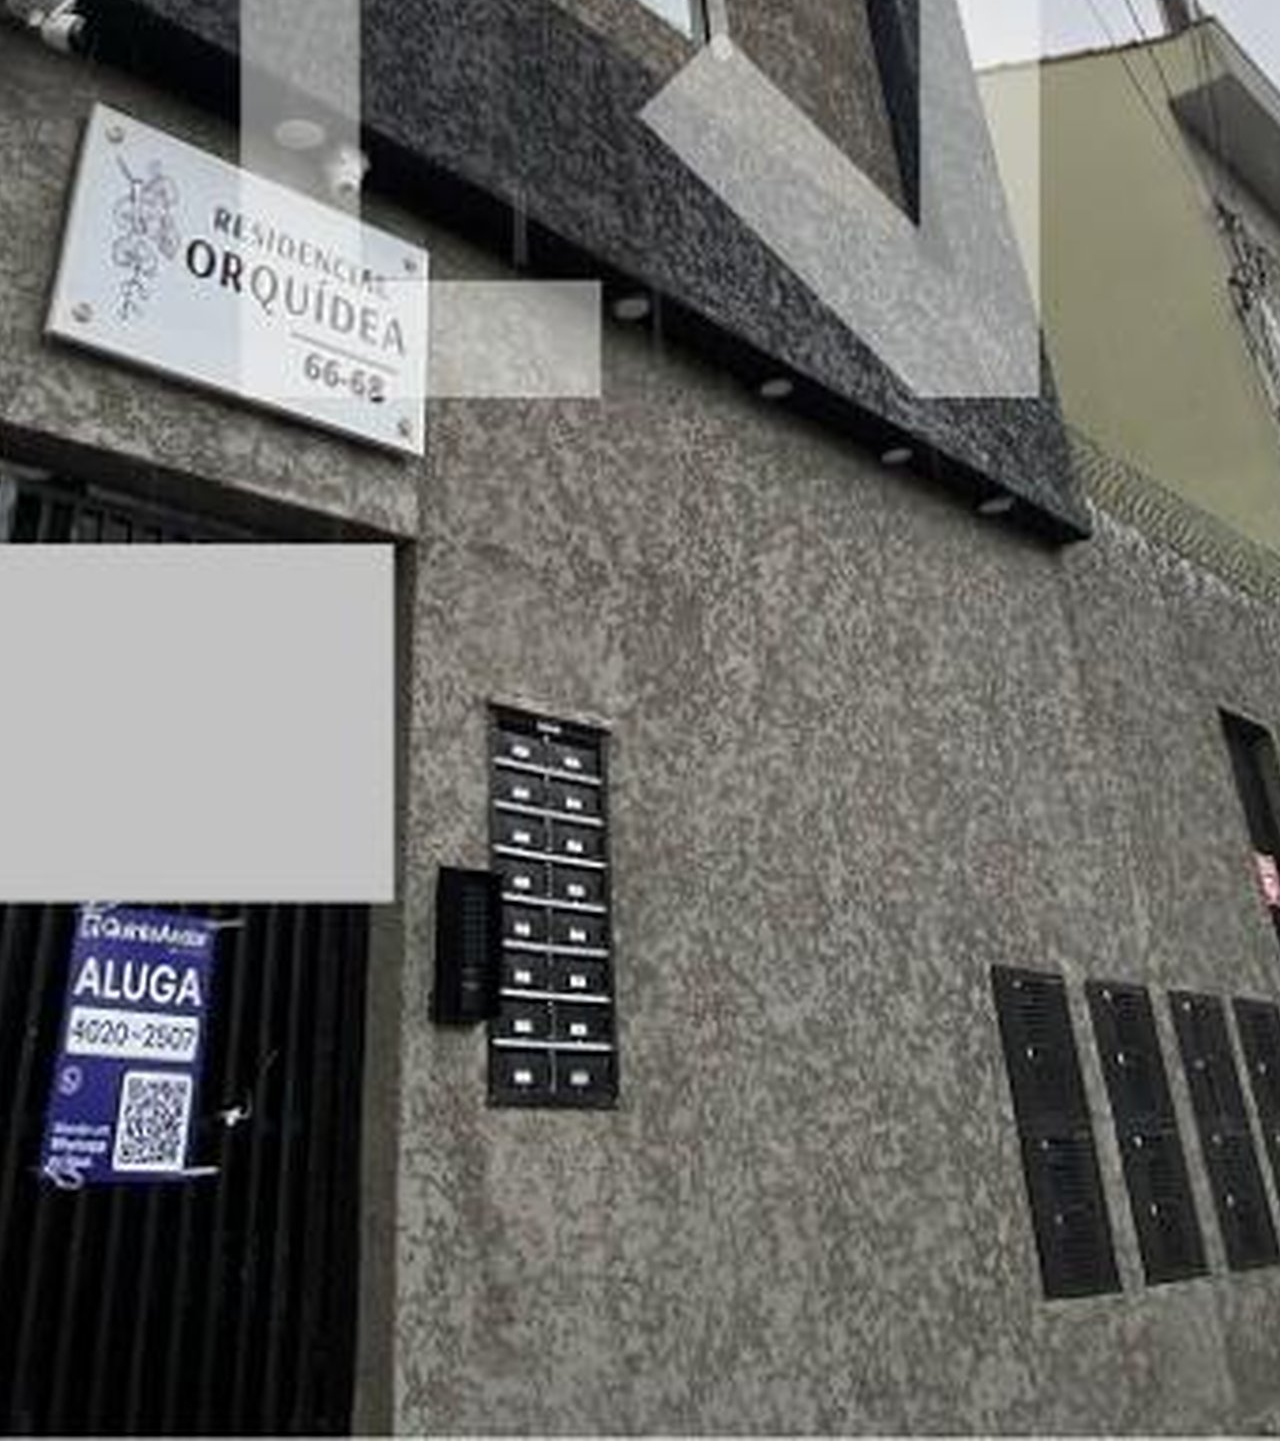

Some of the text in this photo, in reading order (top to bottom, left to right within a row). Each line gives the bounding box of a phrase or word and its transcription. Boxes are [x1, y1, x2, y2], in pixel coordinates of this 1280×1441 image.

[213, 206, 392, 301] RESIDENCIAL
[186, 239, 405, 356] ORQUÍDEA
[73, 955, 203, 1007] ALUGA
[72, 1018, 196, 1052] 4020-2507
